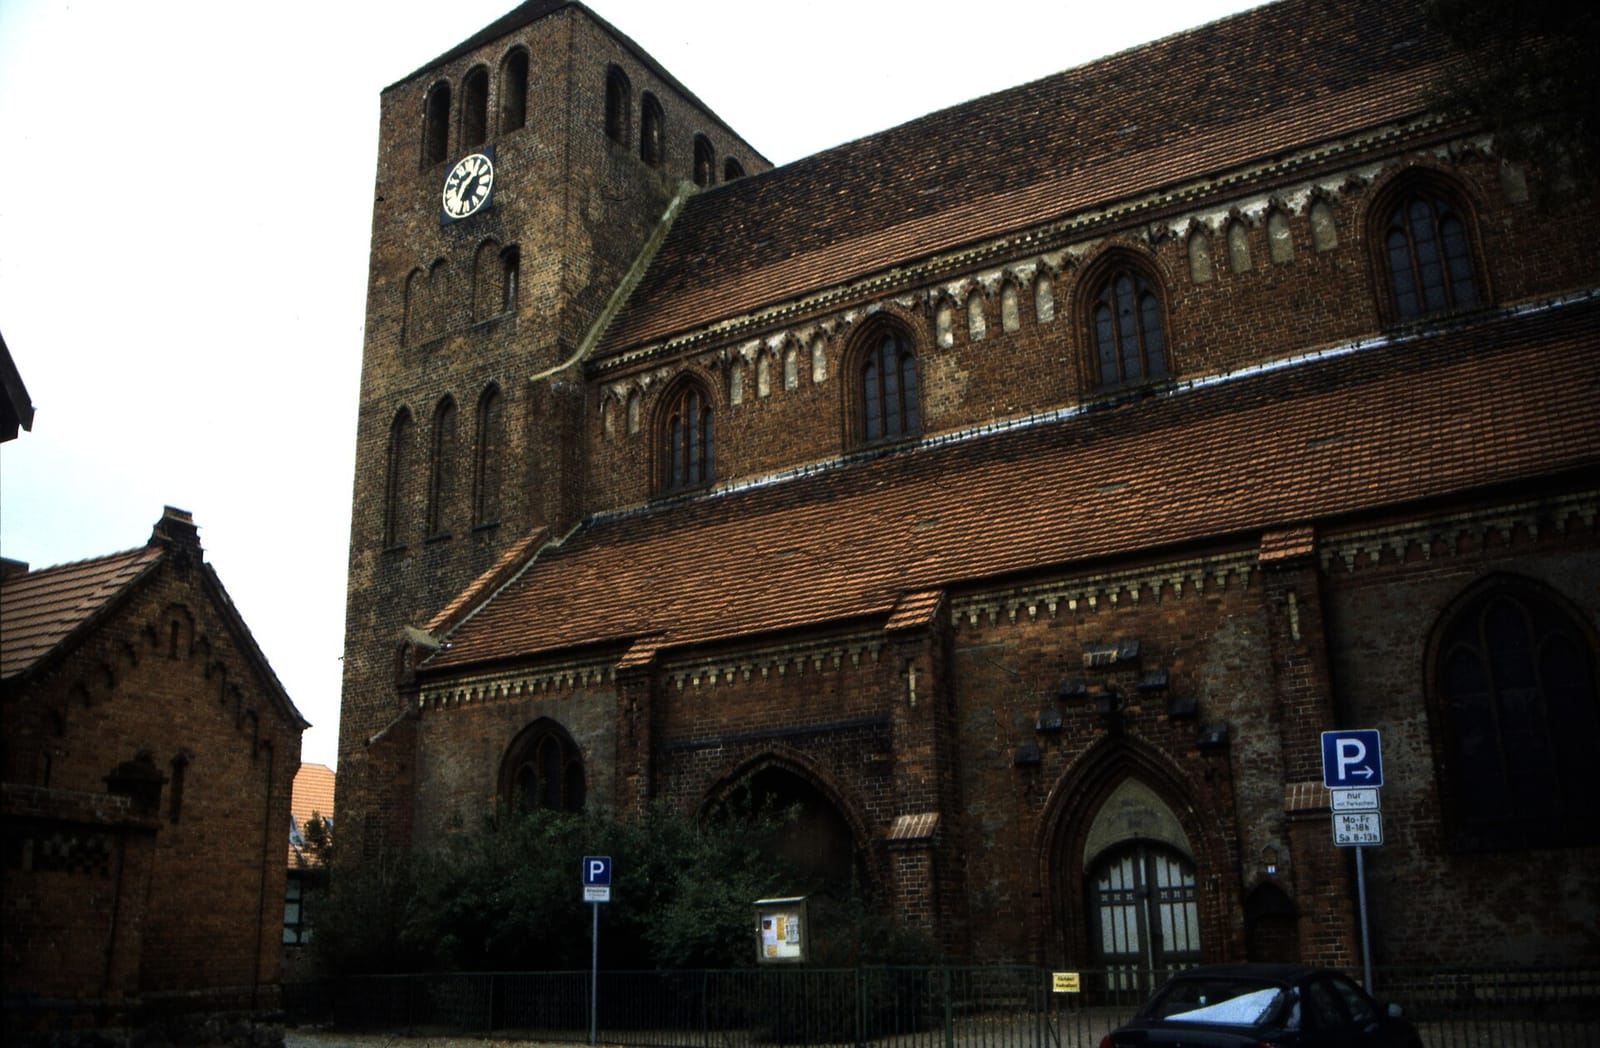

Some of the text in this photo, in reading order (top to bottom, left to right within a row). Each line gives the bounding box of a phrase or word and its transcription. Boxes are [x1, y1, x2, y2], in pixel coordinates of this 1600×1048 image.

[1336, 738, 1366, 780] P
[1343, 815, 1369, 823] Mo-Fr
[1339, 833, 1350, 841] Sa
[590, 860, 604, 882] P
